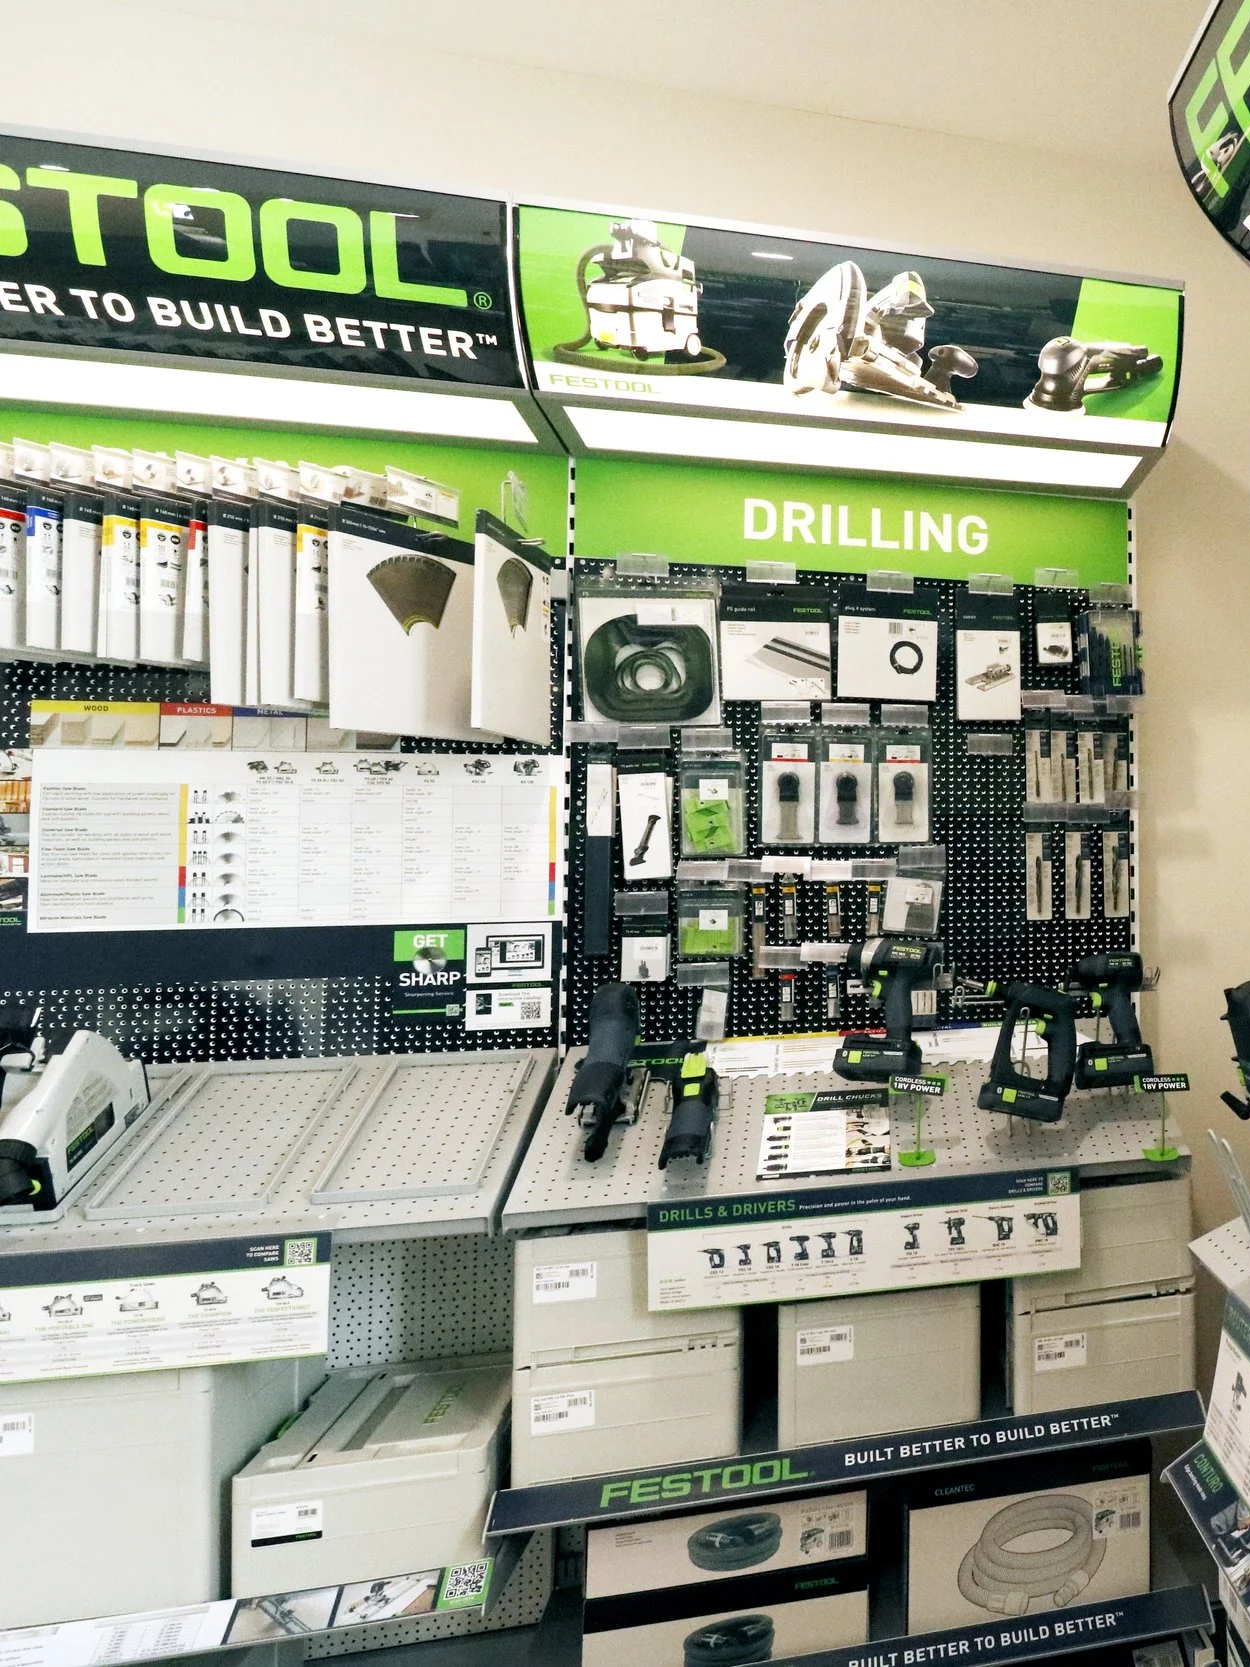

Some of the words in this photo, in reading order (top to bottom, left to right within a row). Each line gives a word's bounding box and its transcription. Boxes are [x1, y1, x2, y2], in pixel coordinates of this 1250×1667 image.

[69, 288, 136, 323] TO
[147, 297, 291, 338] BUILD
[549, 373, 662, 395] FESTOOL
[743, 498, 989, 556] DRILLING
[903, 608, 933, 616] FESTOOL
[84, 704, 109, 712] WOOD
[176, 706, 217, 715] PLASTICS
[413, 934, 448, 948] GET
[892, 945, 924, 954] FESTOOL
[399, 972, 461, 987] SHARP
[895, 1075, 927, 1085] CORDLESS
[1158, 1082, 1187, 1090] POWER
[893, 1082, 910, 1091] 18V
[909, 1084, 941, 1094] POWER
[817, 1094, 844, 1103] DRILL
[845, 1093, 883, 1101] CHUCKS
[659, 1207, 714, 1223] DRILLS
[717, 1206, 728, 1217] &
[732, 1199, 796, 1217] DRIVERS
[799, 1202, 824, 1210] Precision
[423, 1381, 466, 1425] FESTOOL
[844, 1446, 894, 1467] BUILT
[899, 1436, 965, 1458] BETTER
[970, 1433, 991, 1447] TO
[996, 1425, 1045, 1444] BUILD
[1194, 1453, 1223, 1493] CONTURO
[934, 1483, 975, 1496] CLEANTEC
[795, 1577, 839, 1590] FESTOOL
[904, 1641, 970, 1666] BETTER
[974, 1635, 996, 1651] TO
[1001, 1625, 1051, 1648] BUILD
